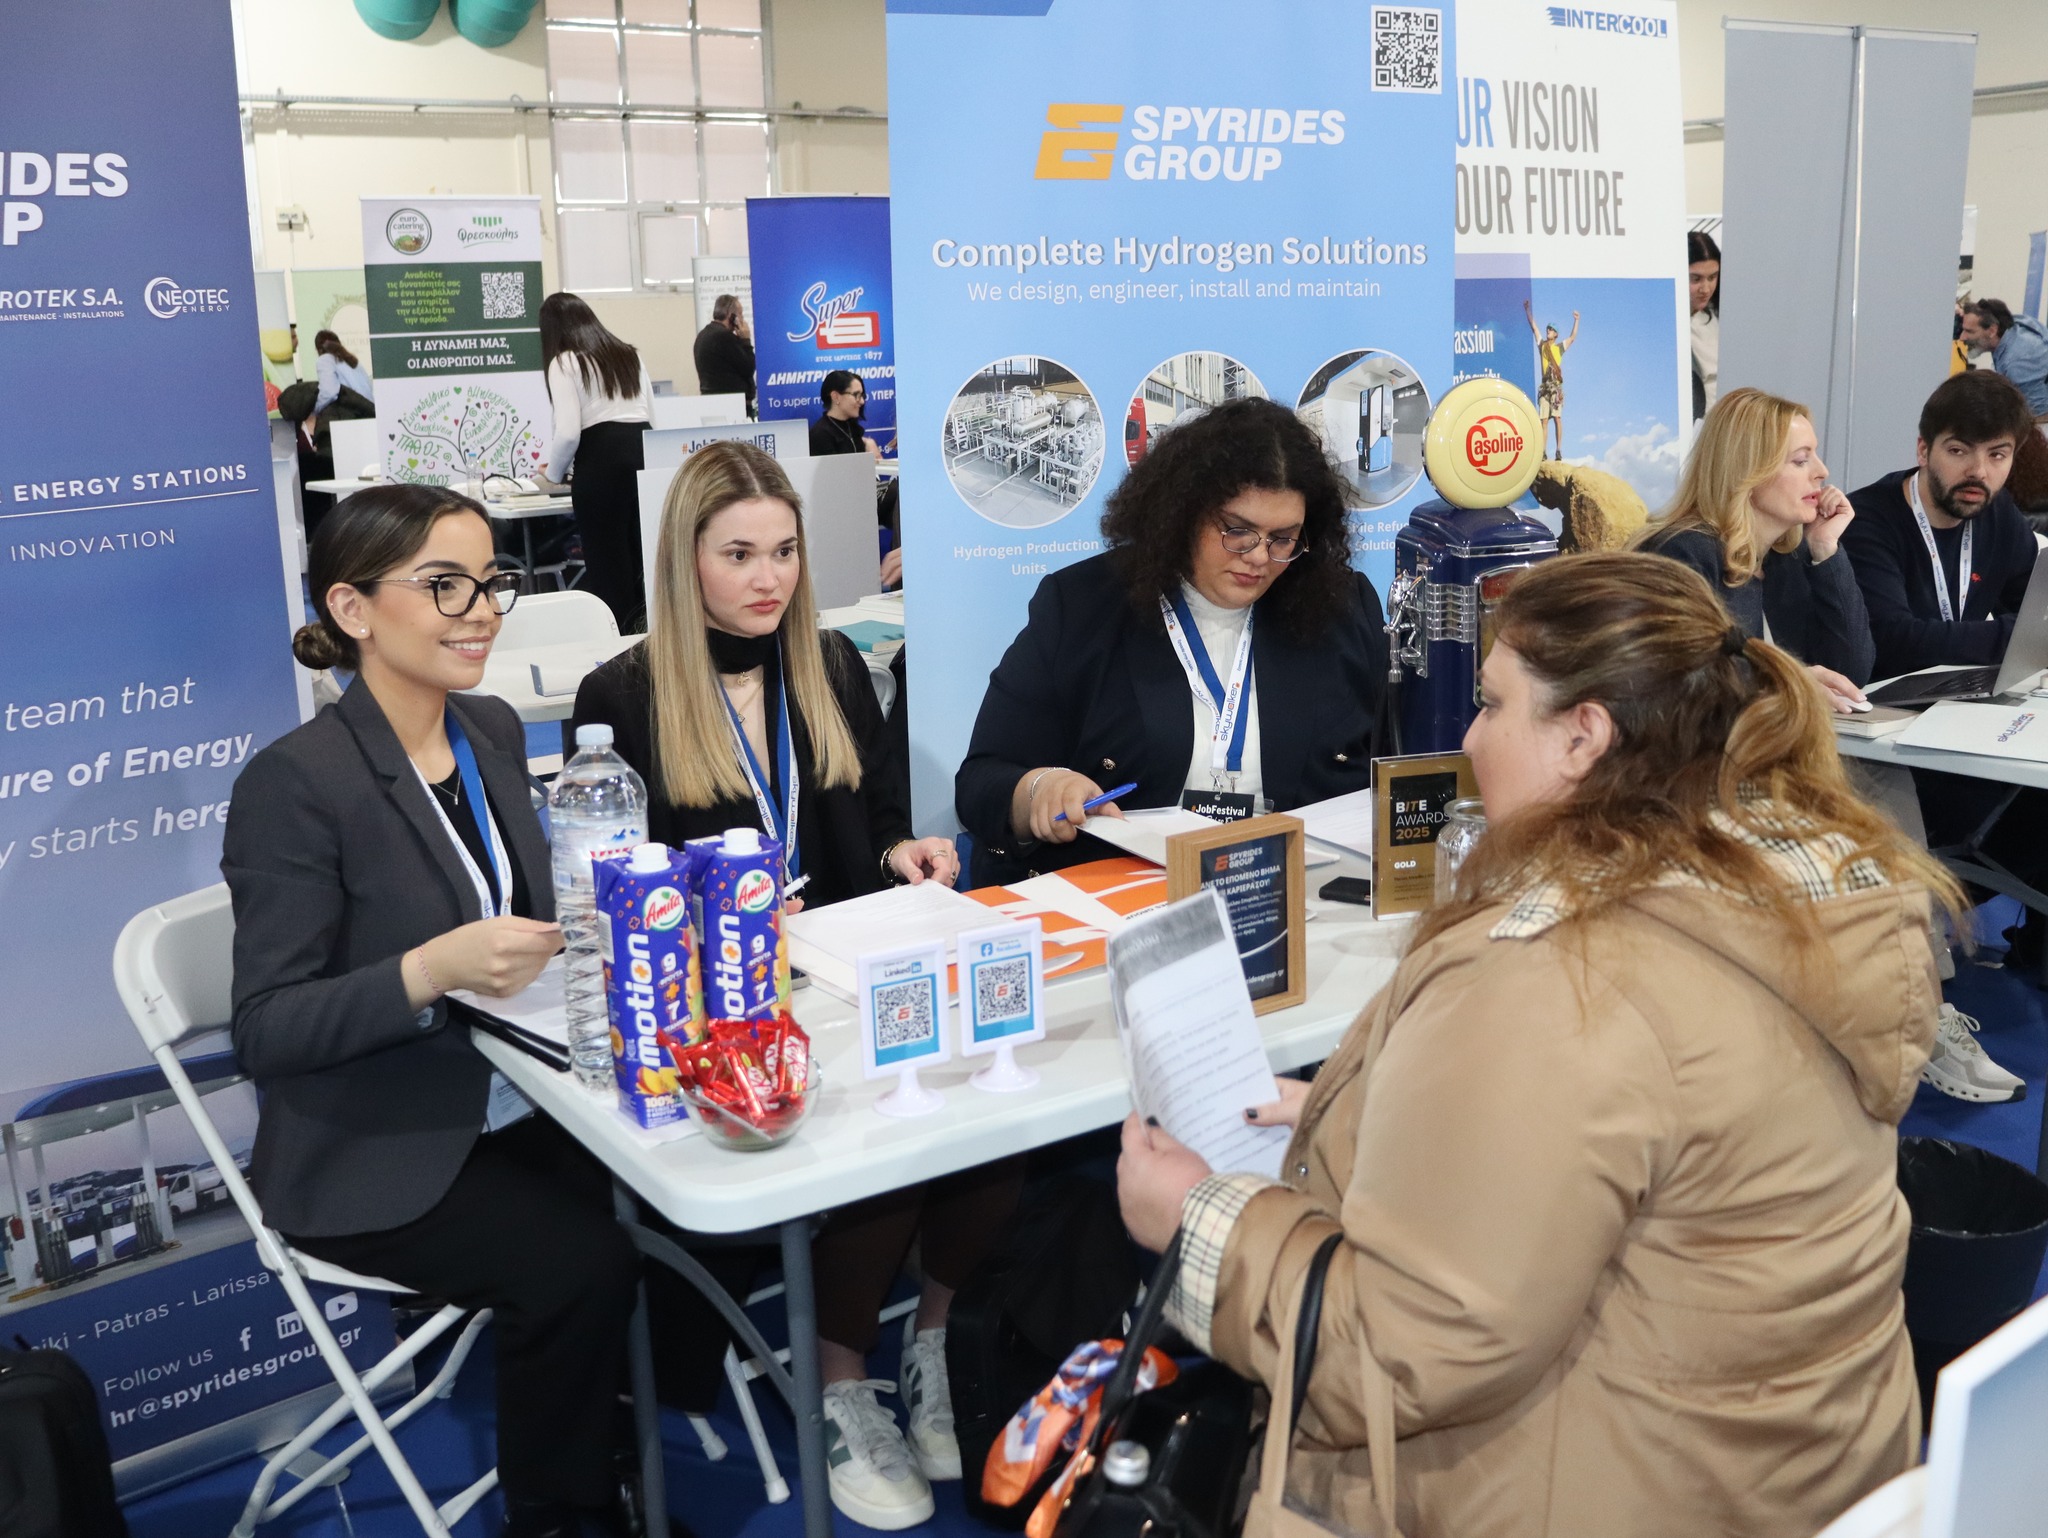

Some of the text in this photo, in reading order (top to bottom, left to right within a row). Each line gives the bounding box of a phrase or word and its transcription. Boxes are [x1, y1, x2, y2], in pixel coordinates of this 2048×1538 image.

[1566, 8, 1667, 38] INTERCOOL
[1131, 105, 1346, 146] SPYRIDES
[1502, 80, 1599, 153] VISION
[1124, 145, 1282, 181] GROUP
[1455, 164, 1626, 236] OUR FUTURE
[393, 222, 424, 231] catering
[931, 236, 1428, 272] Complete Hydrogen Solutions
[82, 288, 123, 307] S.A.
[157, 288, 229, 305] NEOTEC
[967, 278, 1381, 303] We design, engineer, install and maintain
[63, 311, 124, 319] INSTALLATIONS
[182, 305, 231, 313] ENERGY
[787, 281, 864, 342] Super
[412, 337, 510, 351] Η ΔΥΝΑΜΗ ΜΑΣ,
[863, 351, 883, 360] 1877
[407, 354, 516, 369] ΟΙ ΑΝΘΡΩΠΟΙ ΜΑΣ.
[784, 397, 813, 409] super
[396, 434, 443, 460] ΠΑΘΟΣ
[1465, 424, 1523, 467] Gasoline
[14, 464, 247, 502] ENERGY STATIONS
[11, 528, 175, 562] INNOVATION
[954, 539, 1099, 563] Hydrogen Production
[1011, 561, 1047, 576] Units
[5, 677, 196, 731] team that
[1220, 685, 1239, 741] skywalker
[67, 752, 111, 787] of
[122, 733, 258, 779] Energy.
[1395, 800, 1427, 813] BITE
[29, 817, 139, 859] starts
[1395, 826, 1430, 840] 2025
[1228, 846, 1263, 861] SPYRIDES
[1228, 856, 1255, 869] GROUP
[1394, 860, 1416, 870] GOLD
[1225, 870, 1260, 885] ΕΠΟΜΕΝΟ
[1260, 865, 1281, 879] ΒΗΜΑ
[736, 876, 771, 911] Amita
[645, 894, 682, 930] Amita
[752, 934, 766, 954] 9
[663, 952, 677, 974] 9
[627, 931, 661, 1067] motion
[755, 981, 768, 1001] 7
[667, 1000, 681, 1021] 7
[94, 1302, 171, 1339] Patras
[193, 1270, 270, 1306] Larissa
[103, 1348, 214, 1397] Follow us
